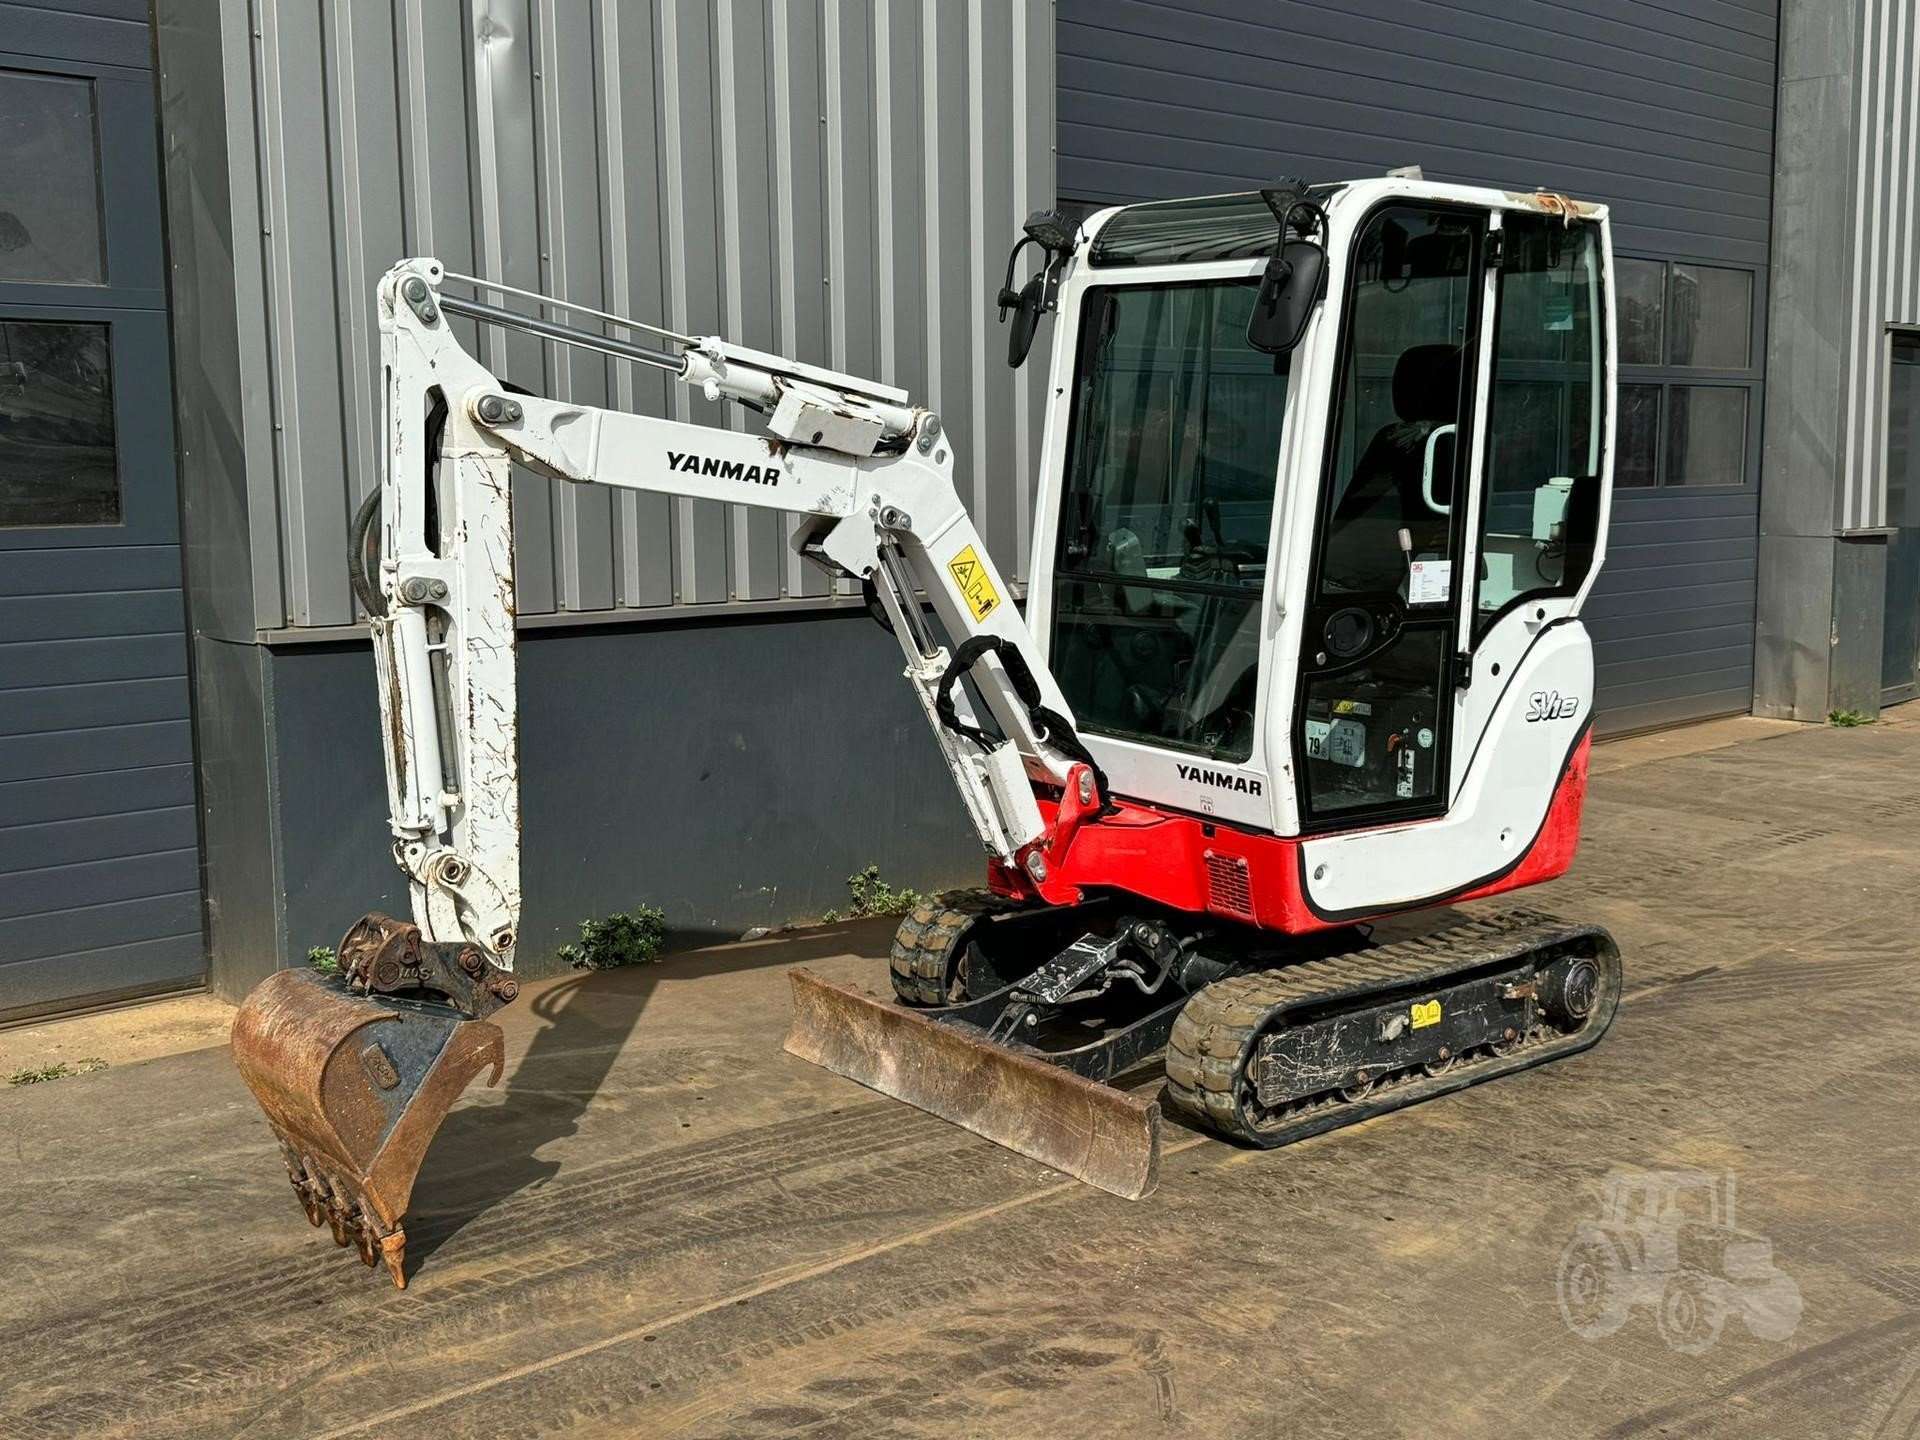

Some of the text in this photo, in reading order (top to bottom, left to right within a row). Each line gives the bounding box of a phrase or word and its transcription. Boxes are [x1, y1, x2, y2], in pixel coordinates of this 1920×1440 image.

[667, 451, 780, 486] YANMAR
[1525, 690, 1579, 722] SV18
[1308, 736, 1321, 754] 79
[1176, 763, 1262, 796] YANMAR
